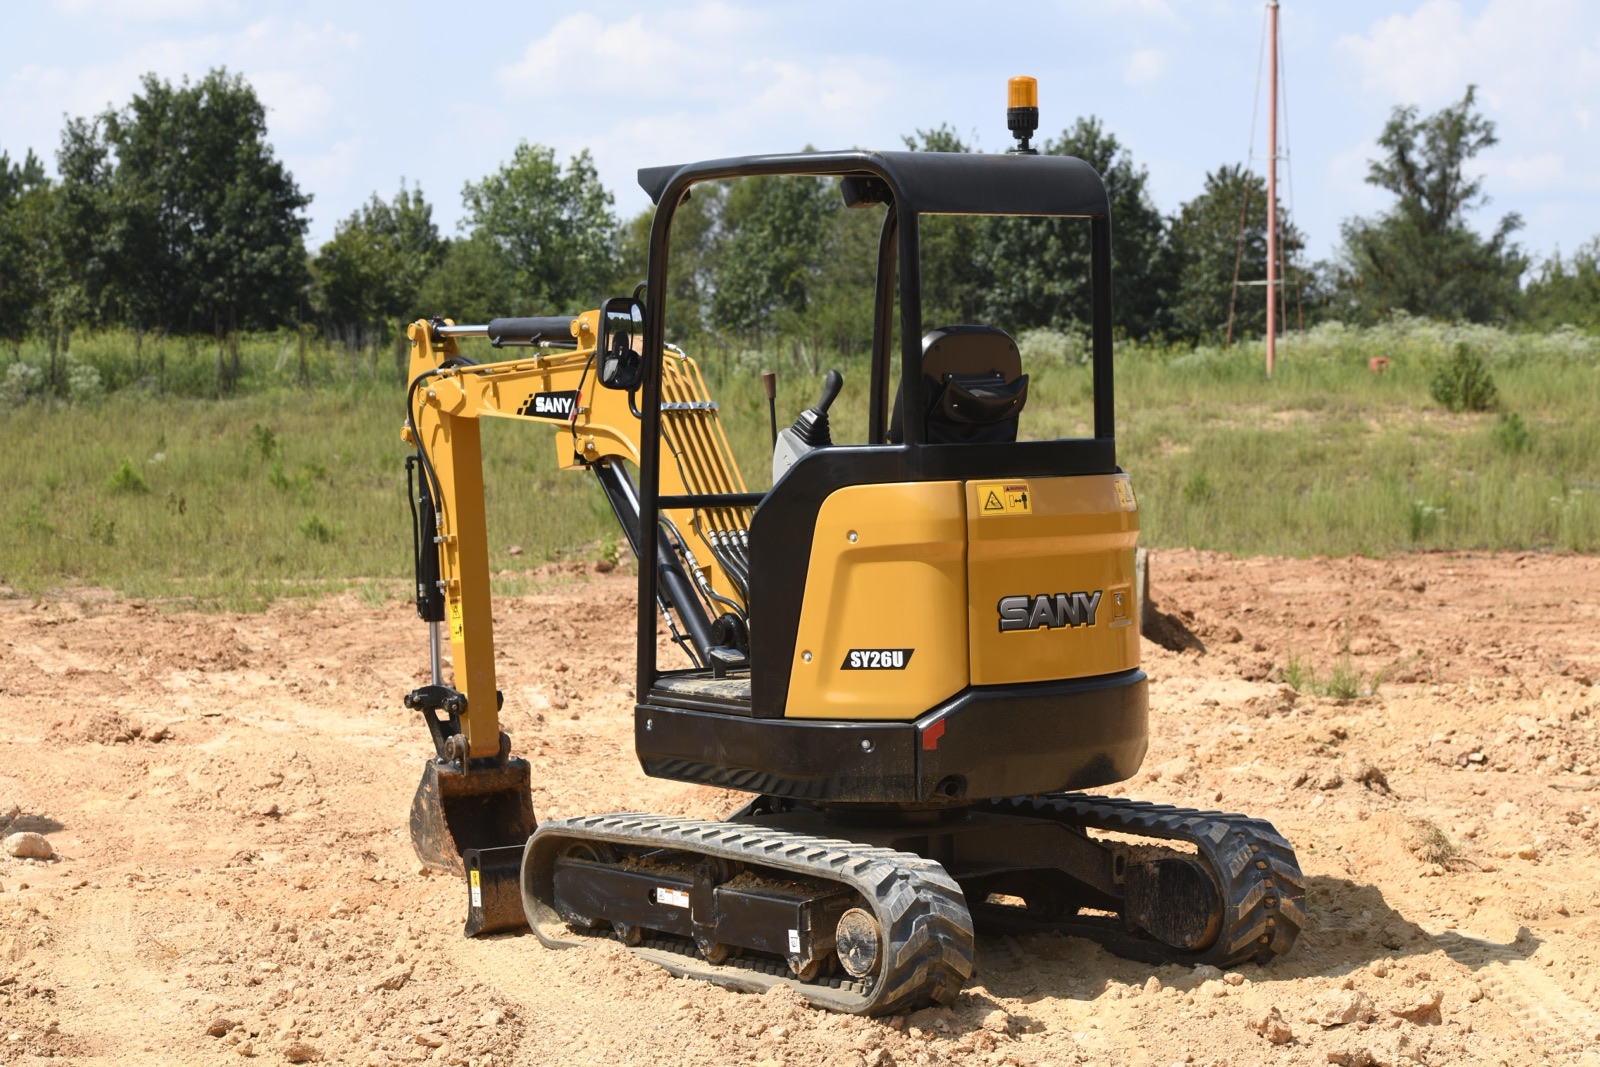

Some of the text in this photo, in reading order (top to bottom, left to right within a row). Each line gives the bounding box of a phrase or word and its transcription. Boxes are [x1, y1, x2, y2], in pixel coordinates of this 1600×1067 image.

[535, 396, 572, 413] SANY
[998, 590, 1102, 631] SANY
[850, 650, 904, 668] SY26U
